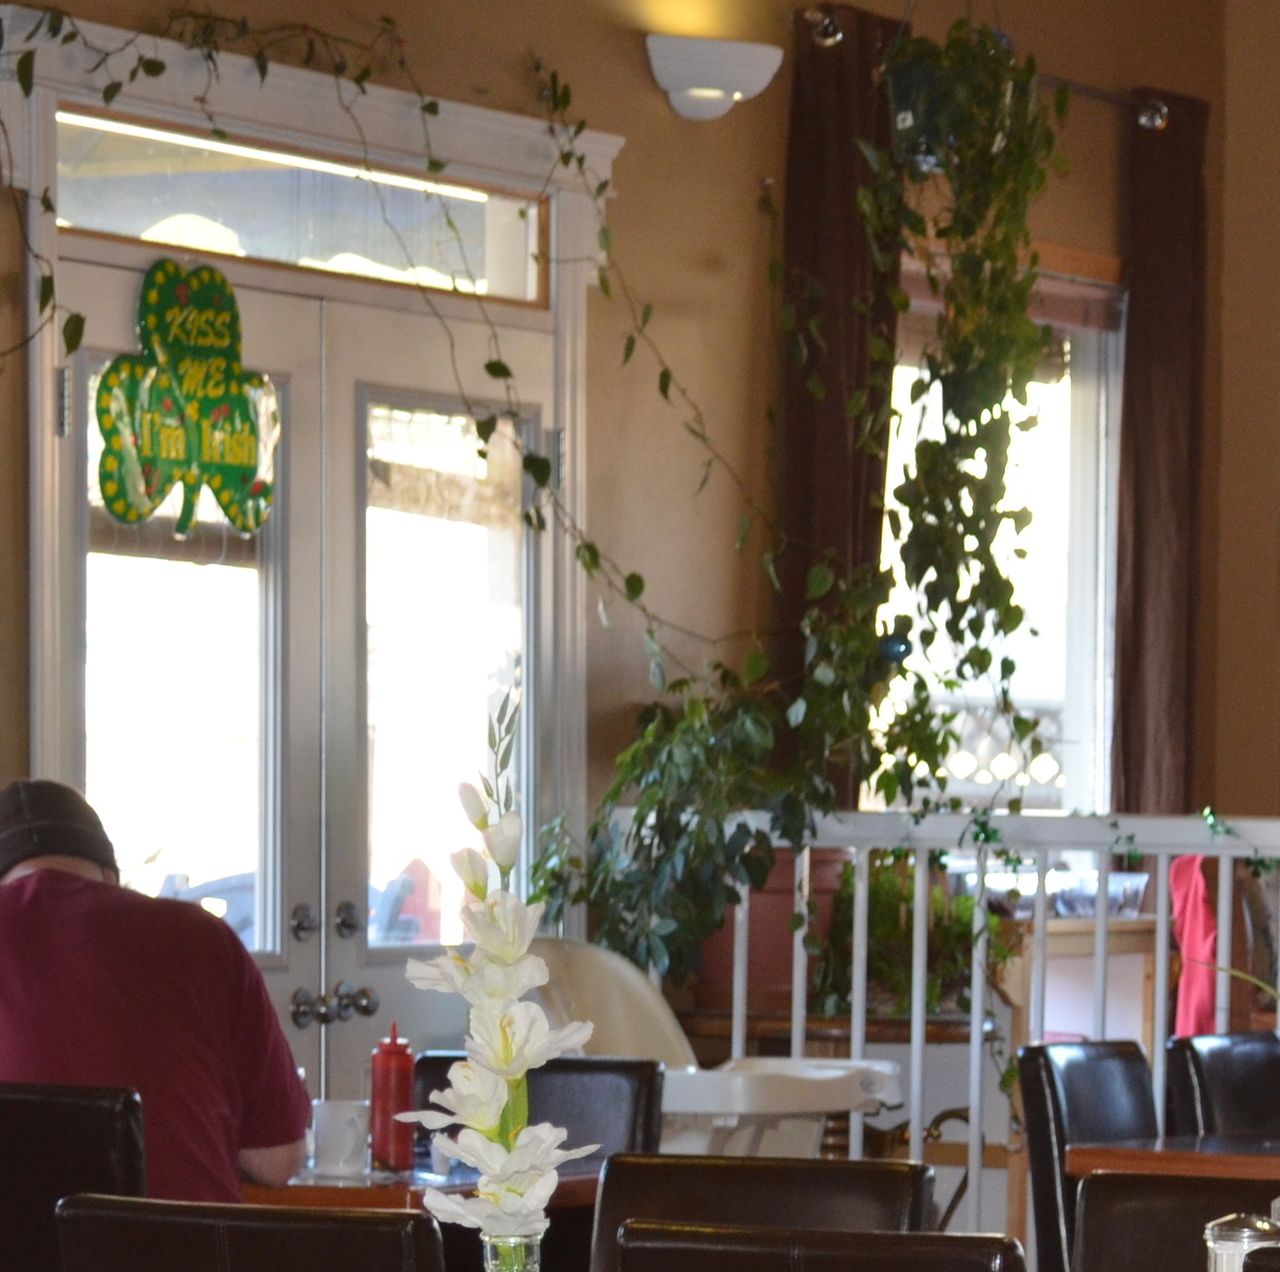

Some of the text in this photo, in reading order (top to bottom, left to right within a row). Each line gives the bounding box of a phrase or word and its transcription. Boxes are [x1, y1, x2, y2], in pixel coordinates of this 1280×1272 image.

[165, 308, 231, 347] KISS
[178, 357, 226, 399] ME
[142, 411, 257, 466] I'm Irish
